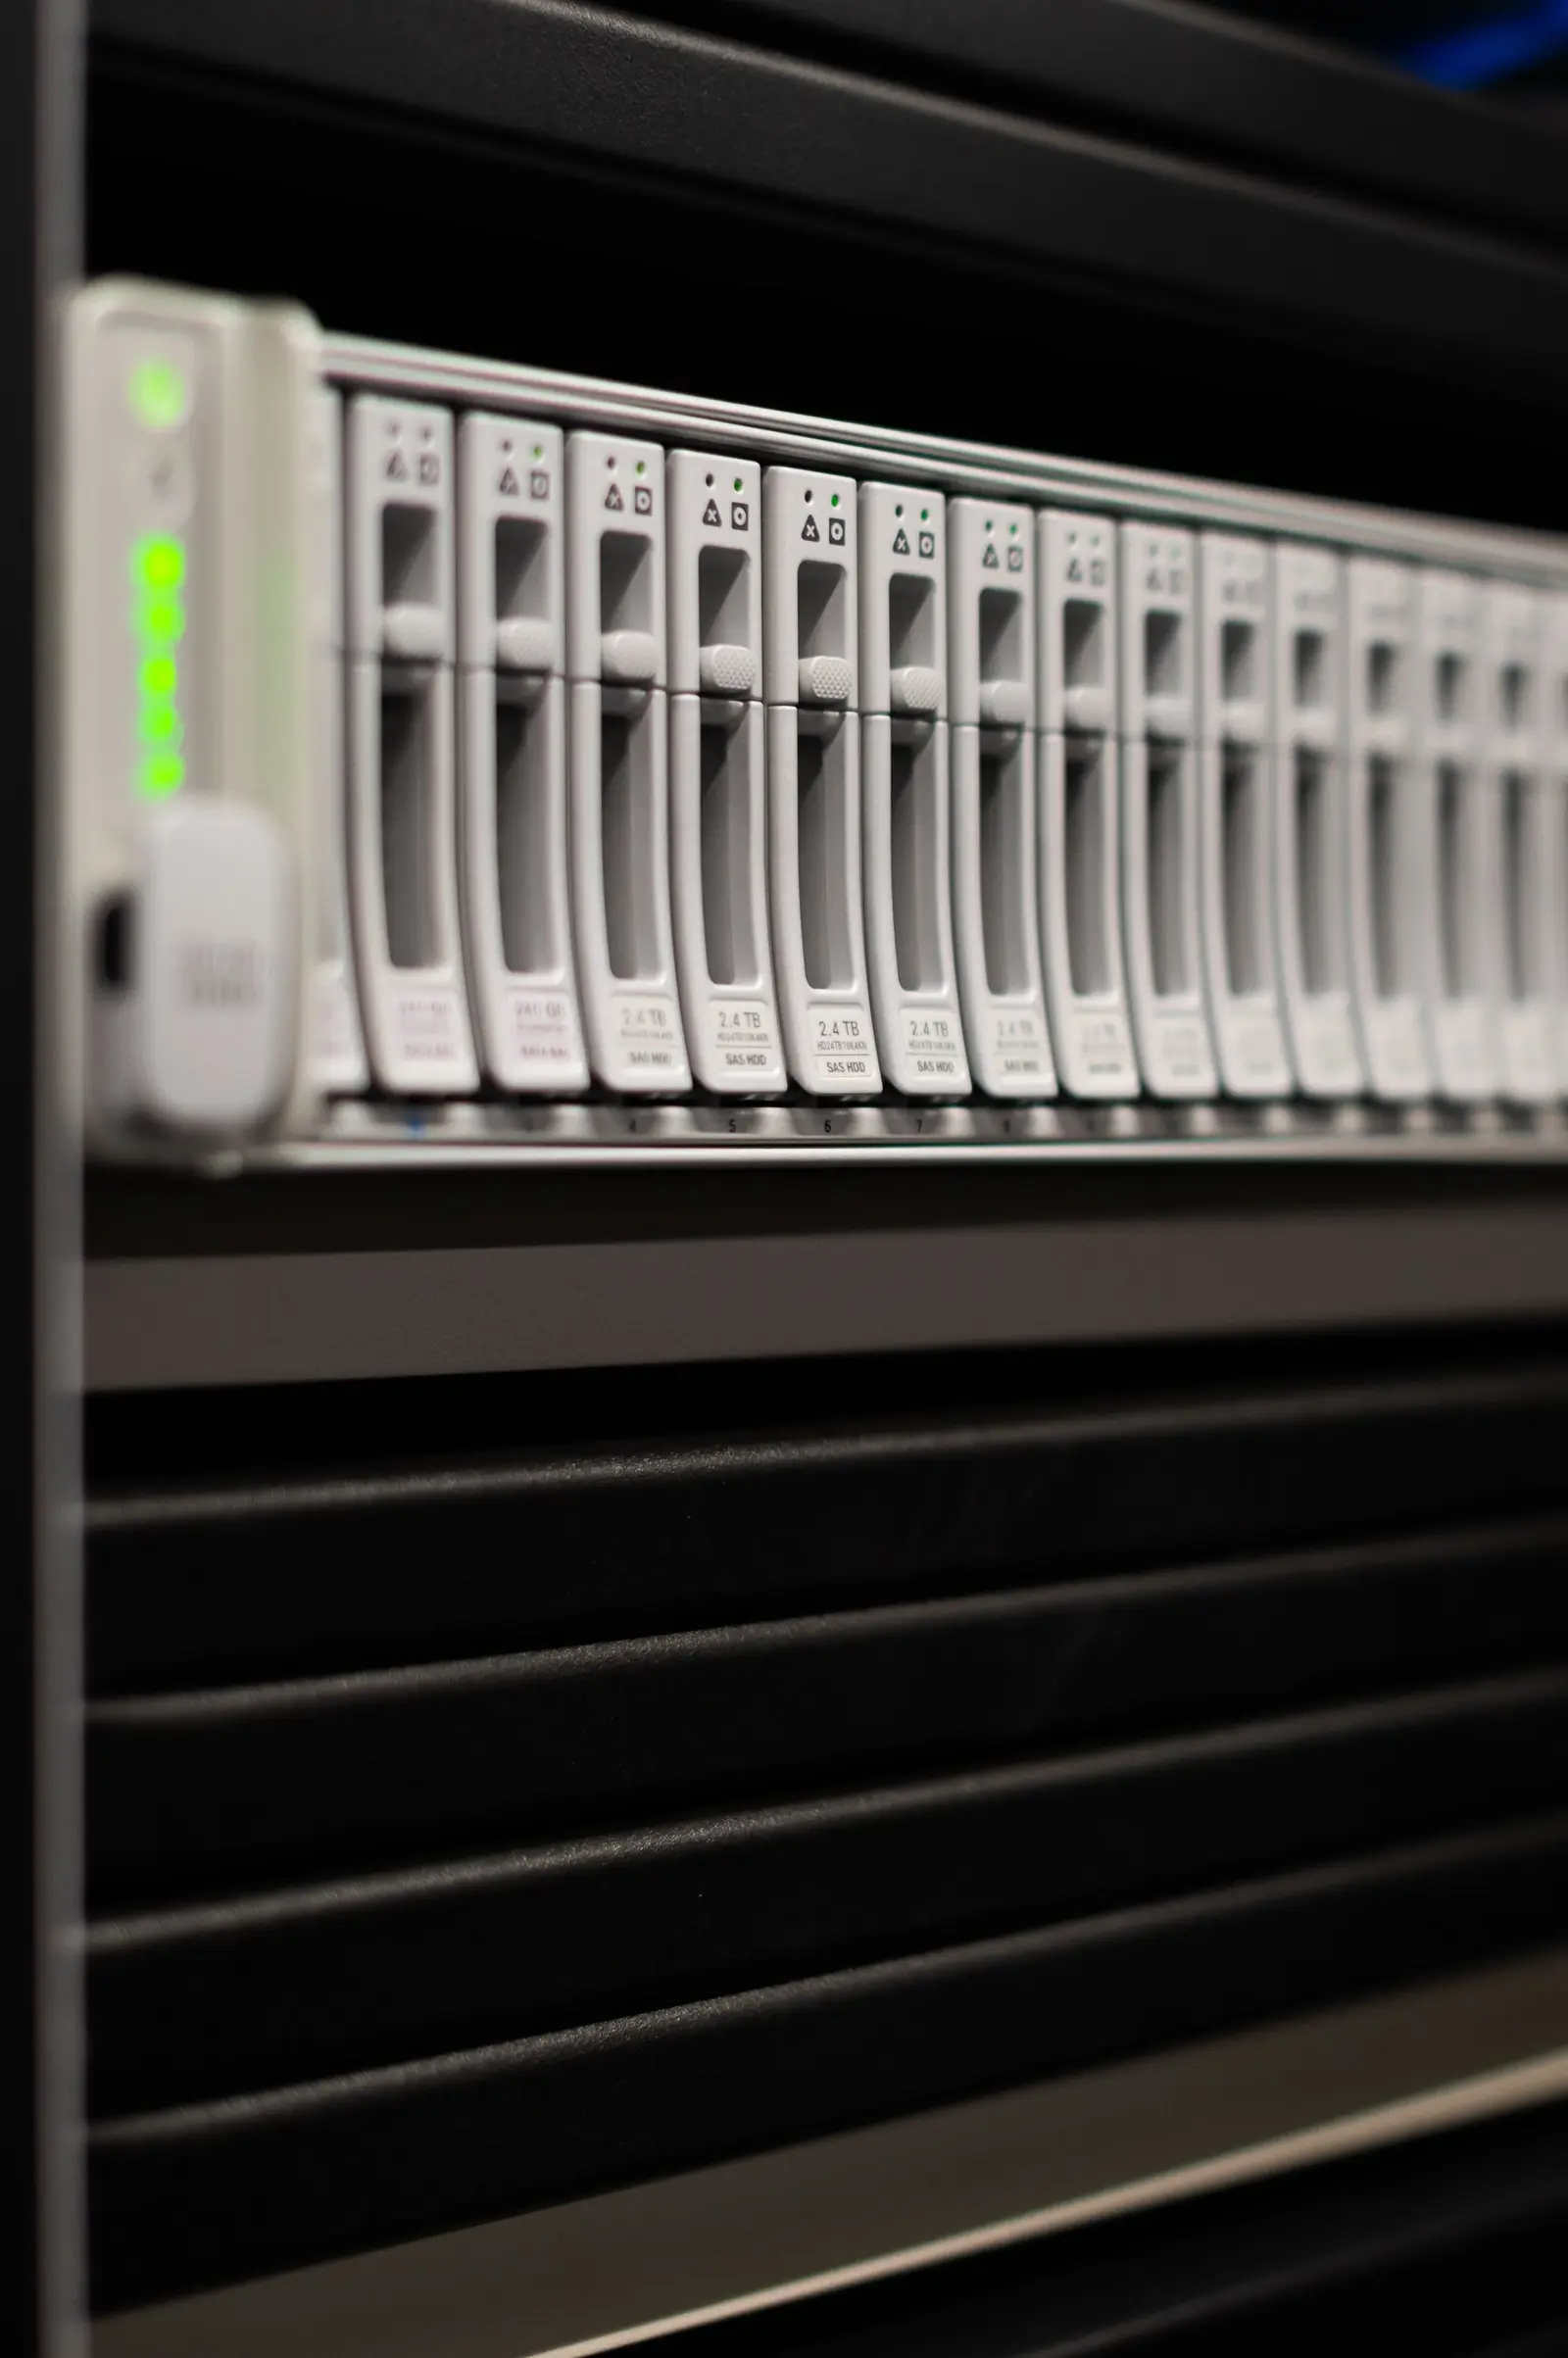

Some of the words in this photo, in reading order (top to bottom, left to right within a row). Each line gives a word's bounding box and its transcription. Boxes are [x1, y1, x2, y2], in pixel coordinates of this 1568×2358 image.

[718, 1011, 740, 1028] 2.4
[743, 1011, 761, 1028] TB
[818, 1020, 840, 1037] 2.4
[842, 1020, 859, 1037] TB
[909, 1020, 930, 1037] 2.4
[932, 1020, 949, 1038] TB
[725, 1053, 745, 1065] SAS
[747, 1053, 766, 1066] HDD
[826, 1061, 845, 1073] SAS
[847, 1061, 865, 1073] HDD
[916, 1060, 934, 1073] SAS
[936, 1060, 955, 1073] HDD
[728, 1118, 737, 1134] 5
[824, 1119, 832, 1134] 6
[916, 1118, 923, 1133] 7
